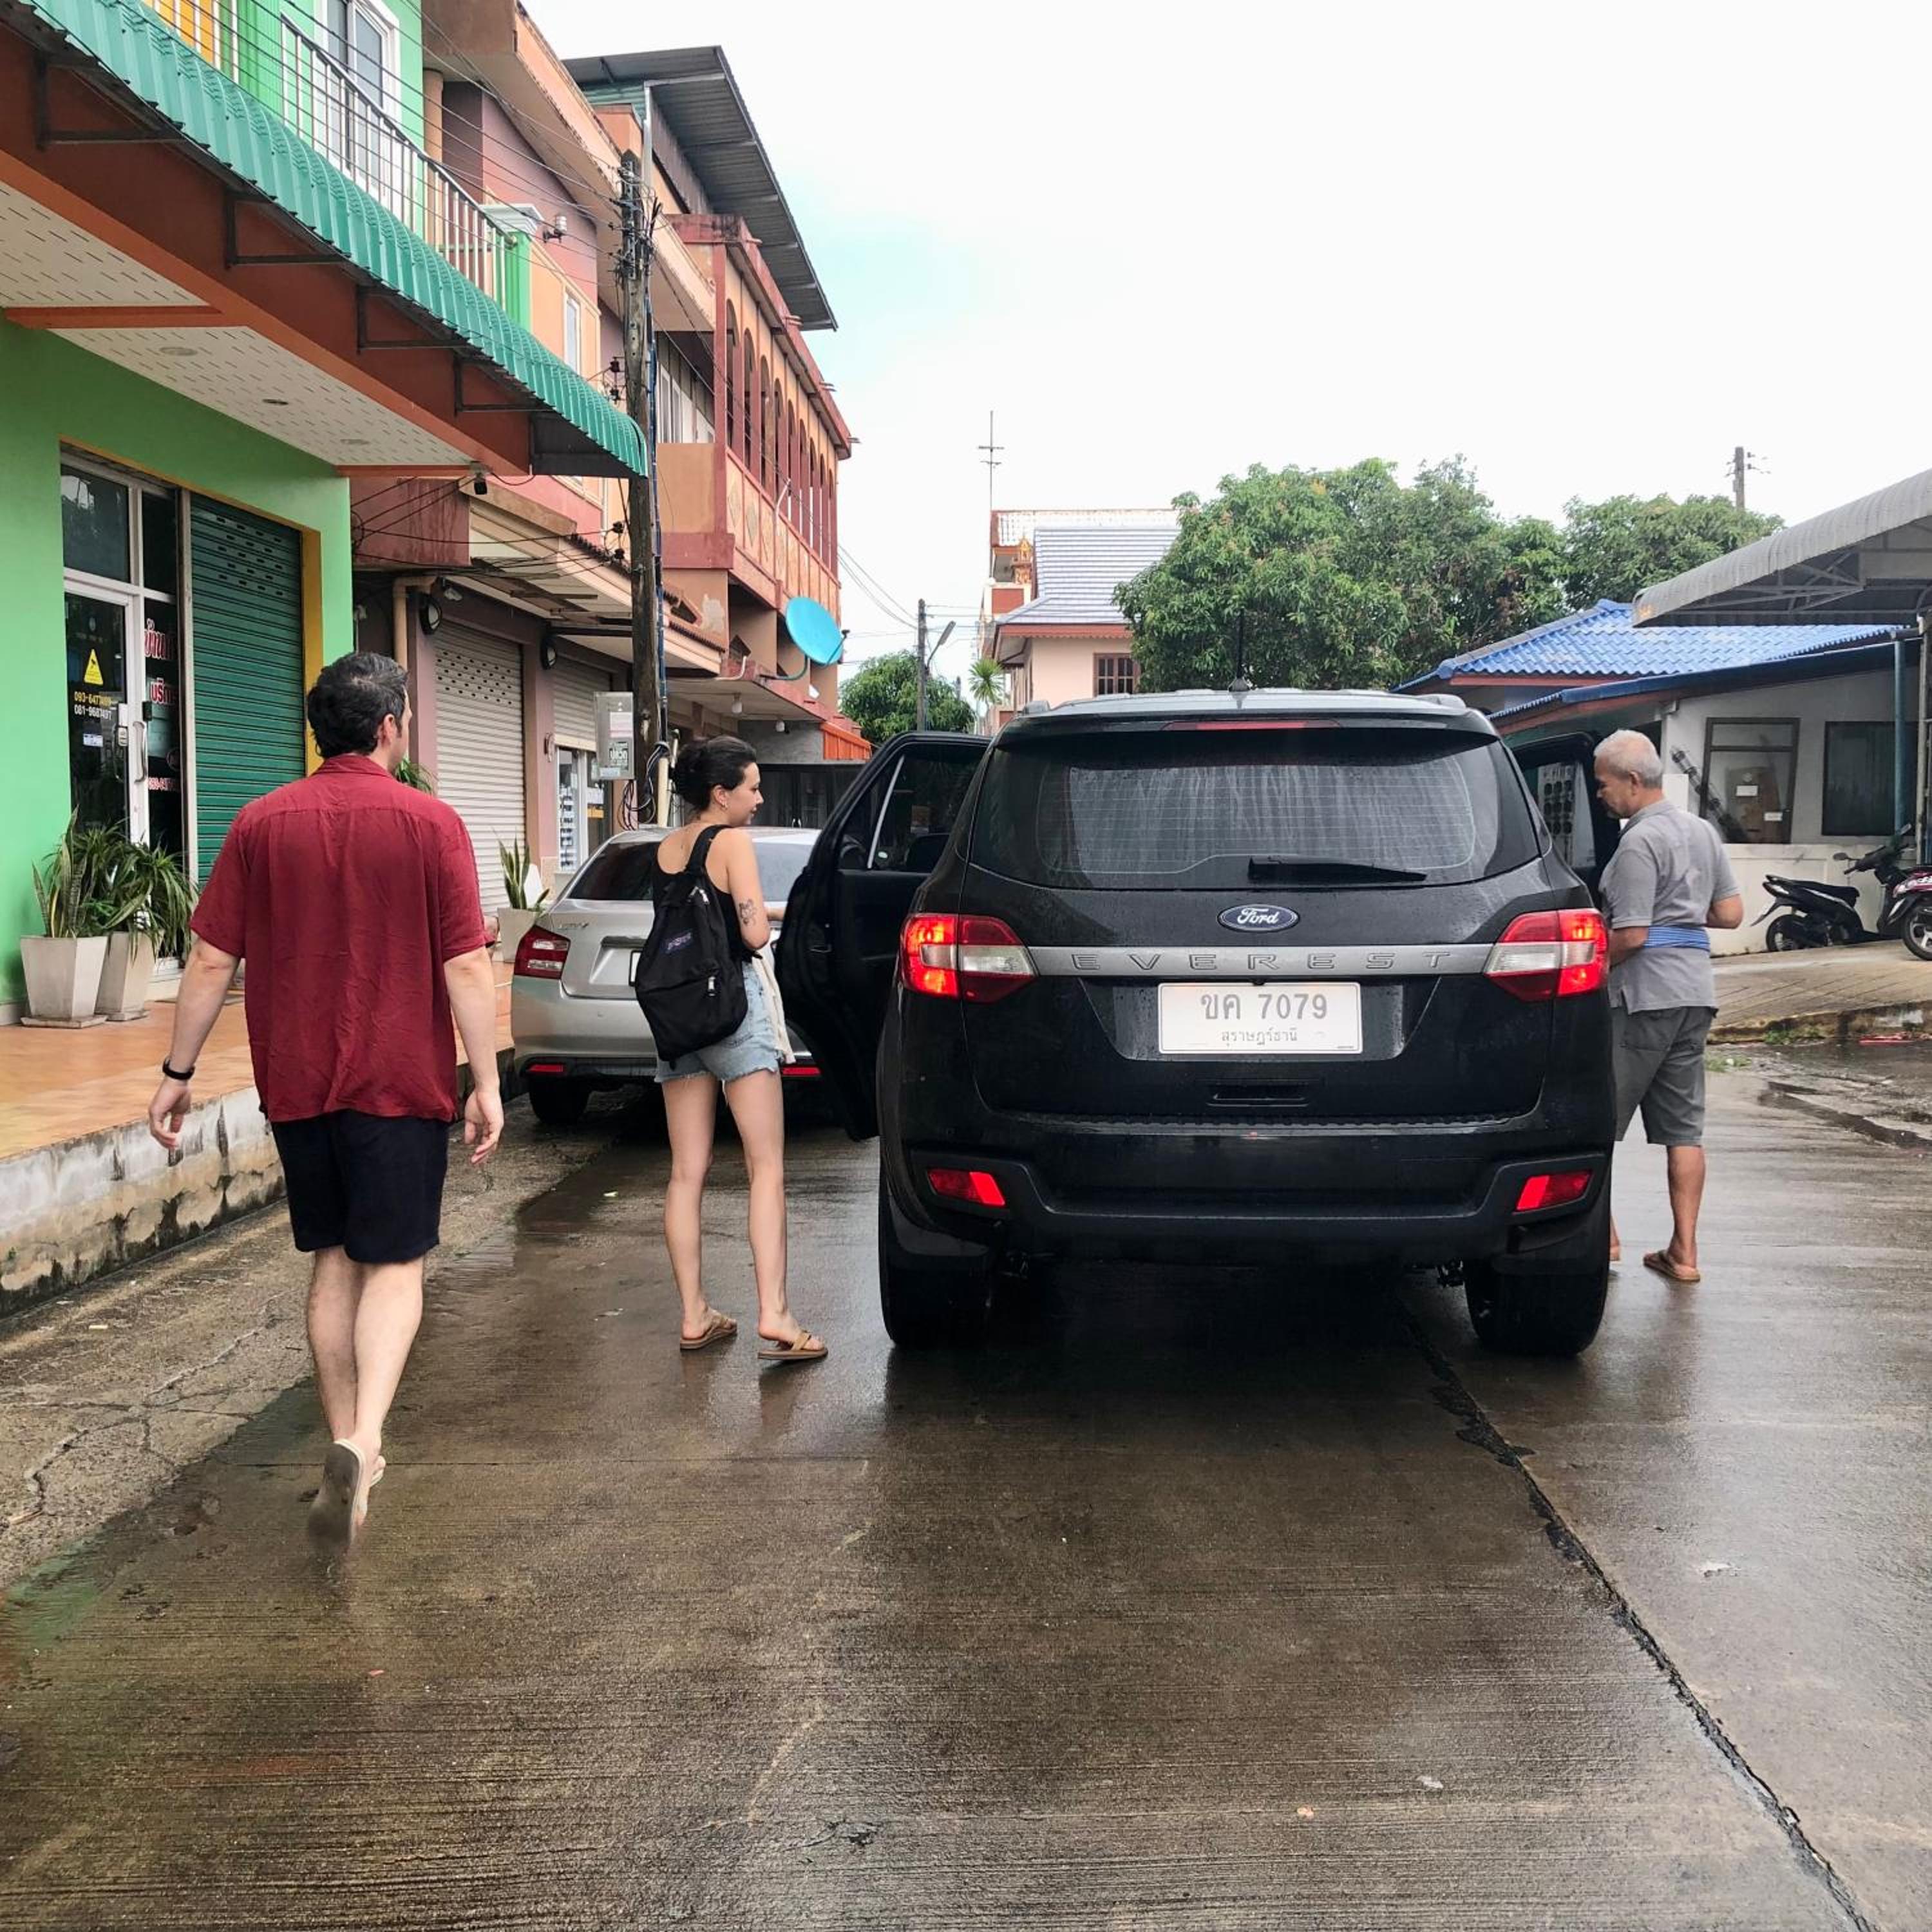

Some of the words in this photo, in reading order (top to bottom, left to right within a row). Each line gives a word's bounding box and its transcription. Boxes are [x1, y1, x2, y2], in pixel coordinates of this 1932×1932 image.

[1236, 907, 1280, 925] Ford
[1071, 951, 1450, 971] EVEREST
[1200, 993, 1241, 1019] ขค
[1258, 993, 1328, 1019] 7079
[1221, 1027, 1298, 1046] สุราษฎร์ธานี
